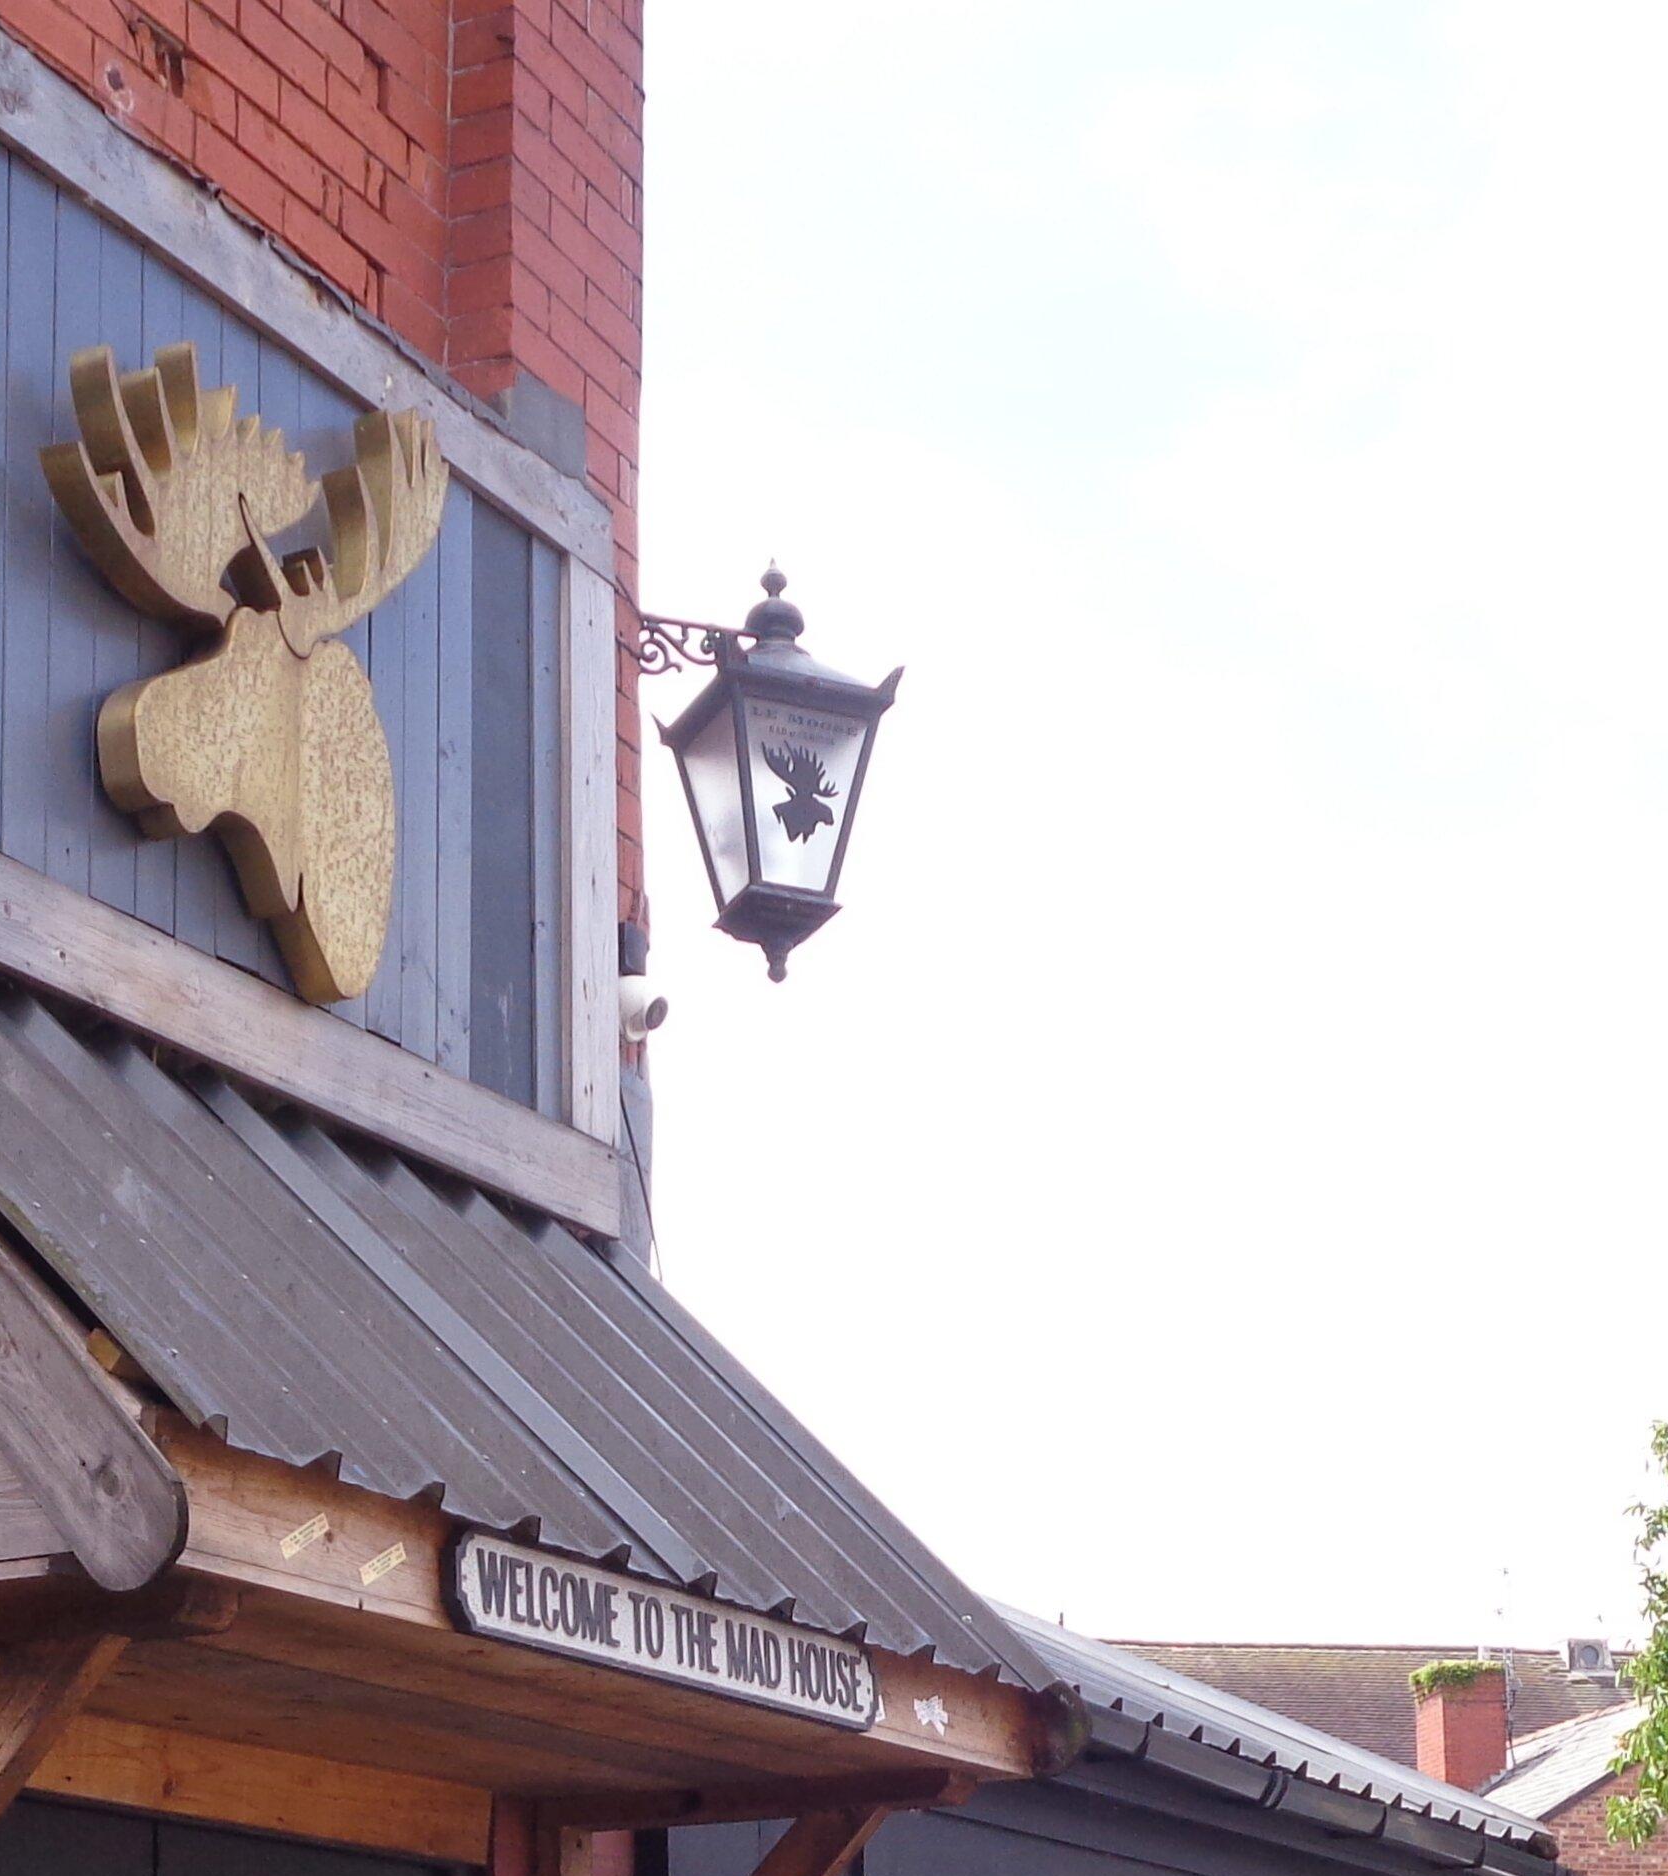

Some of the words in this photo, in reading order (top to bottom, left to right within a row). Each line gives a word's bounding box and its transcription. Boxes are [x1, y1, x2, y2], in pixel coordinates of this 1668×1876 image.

[475, 1547, 620, 1648] WELCOME
[628, 1590, 665, 1659] TO
[670, 1603, 720, 1674] THE
[724, 1618, 782, 1690] MAD
[787, 1636, 865, 1713] HOUSE
